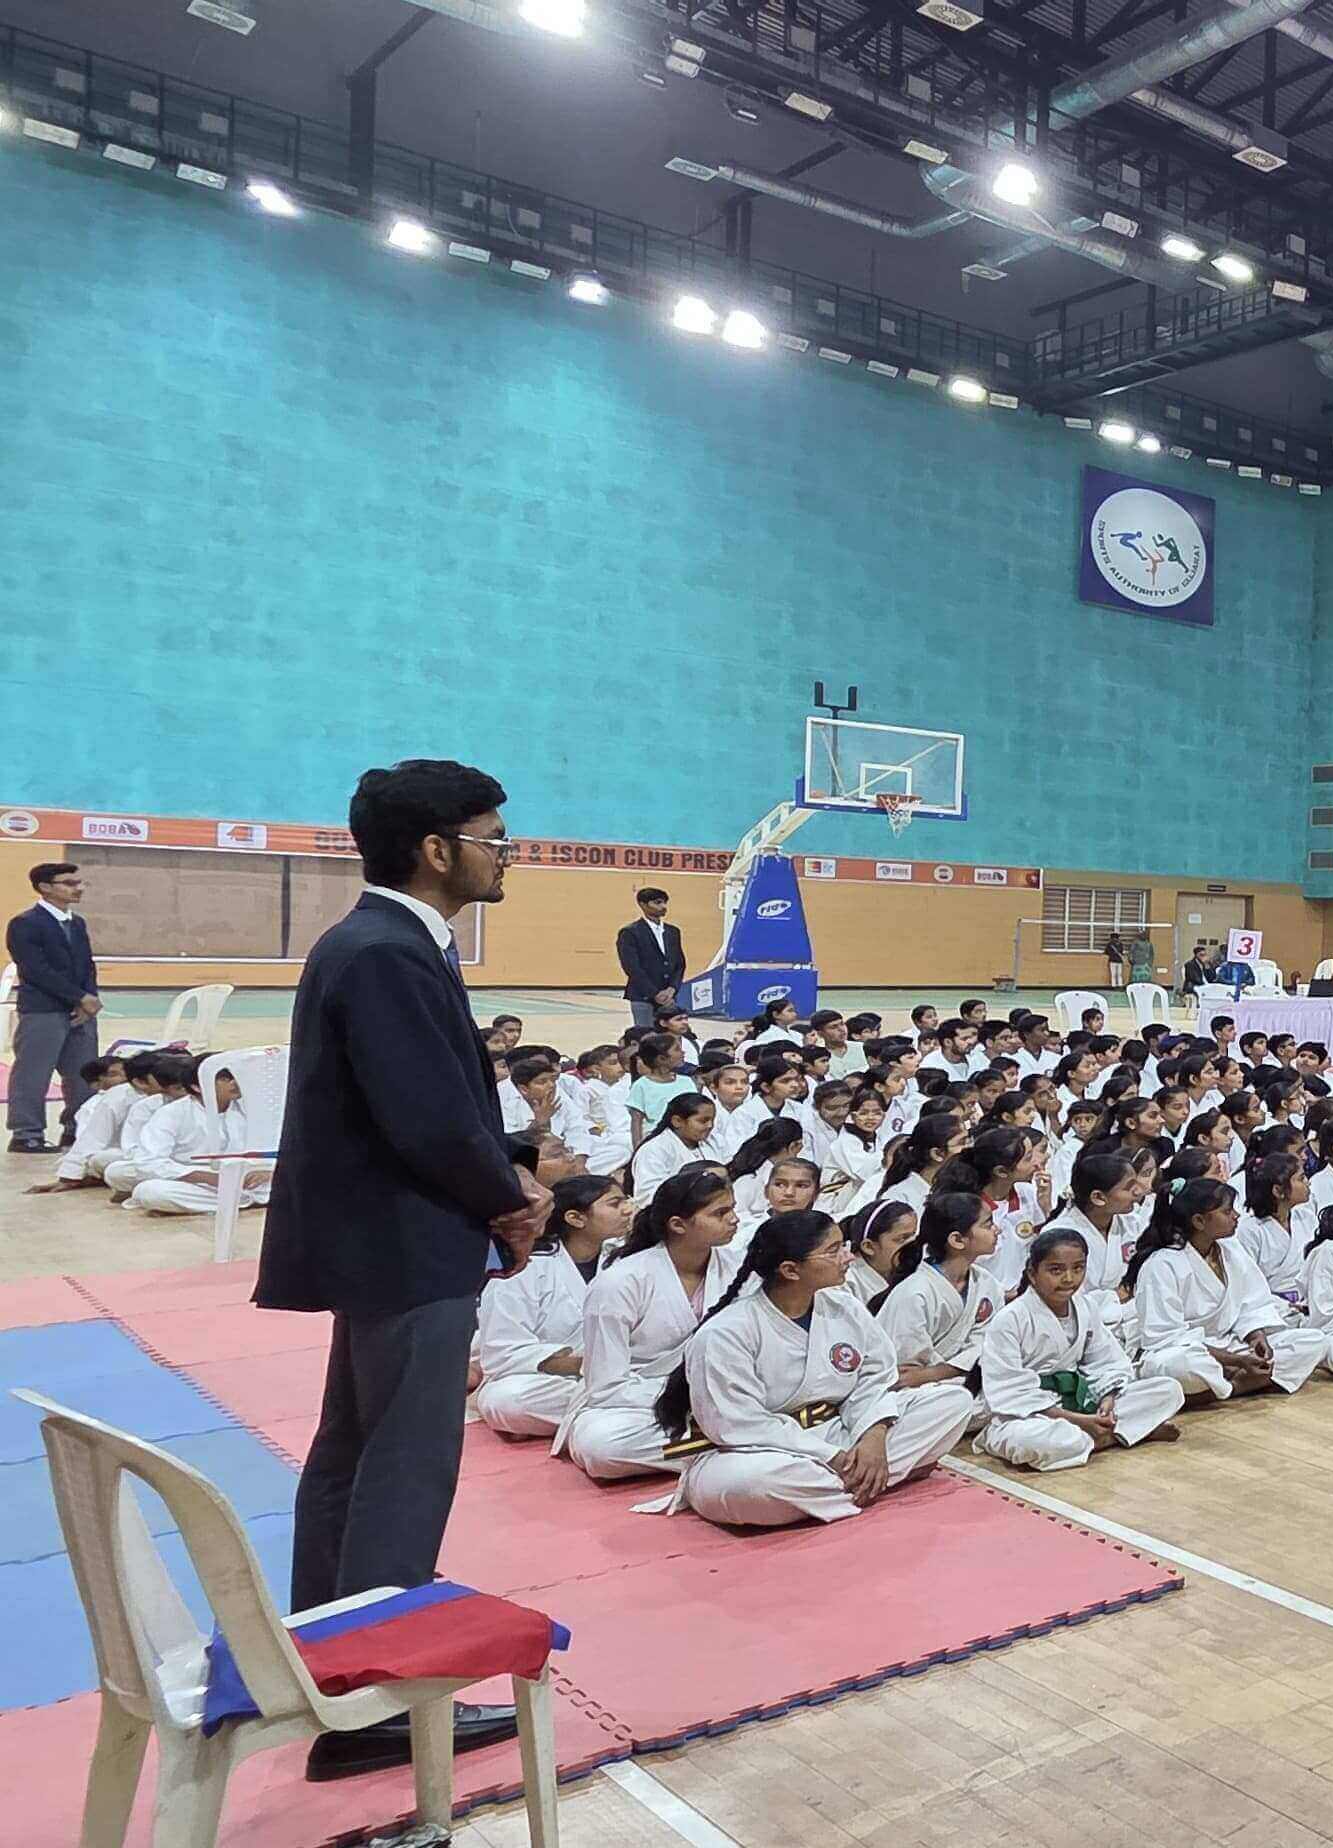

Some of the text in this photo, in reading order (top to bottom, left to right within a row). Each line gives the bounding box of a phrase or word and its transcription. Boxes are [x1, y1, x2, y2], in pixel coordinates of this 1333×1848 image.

[552, 845, 616, 866] ISCON
[624, 849, 674, 868] CLUB
[1236, 936, 1255, 957] 3
